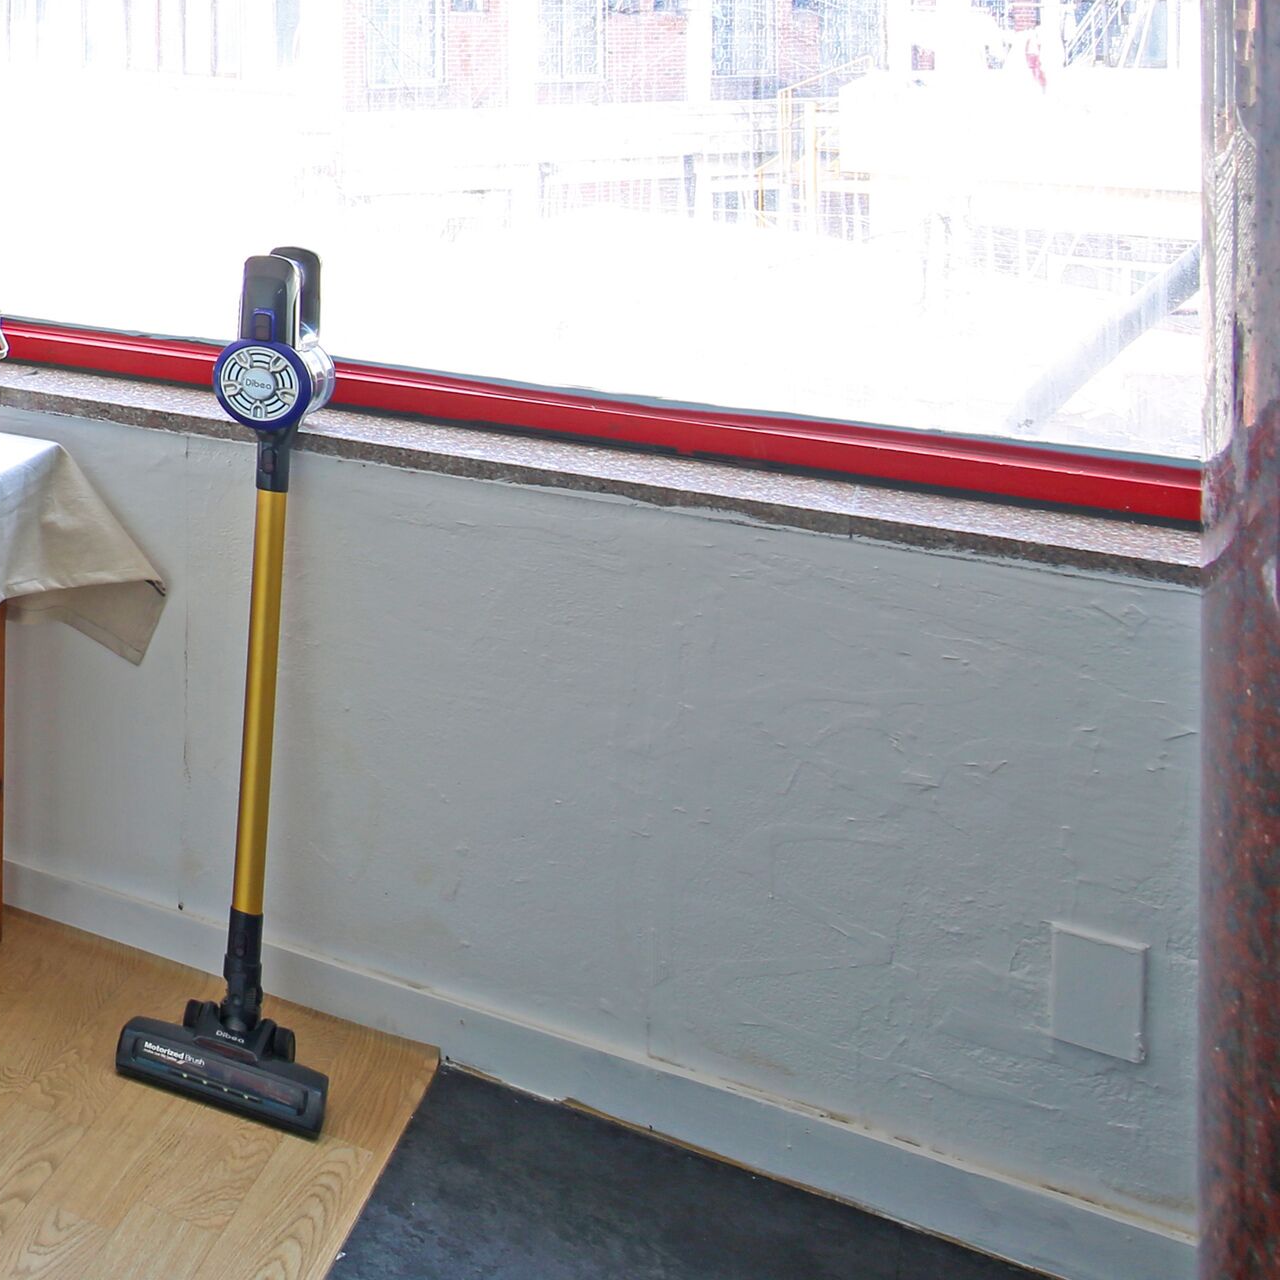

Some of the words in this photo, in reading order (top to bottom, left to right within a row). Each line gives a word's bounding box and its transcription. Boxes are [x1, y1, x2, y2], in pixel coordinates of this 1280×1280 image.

[245, 378, 272, 390] Dibea
[215, 1029, 245, 1044] Dibea
[143, 1041, 185, 1060] Motorized
[184, 1053, 205, 1068] Brush
